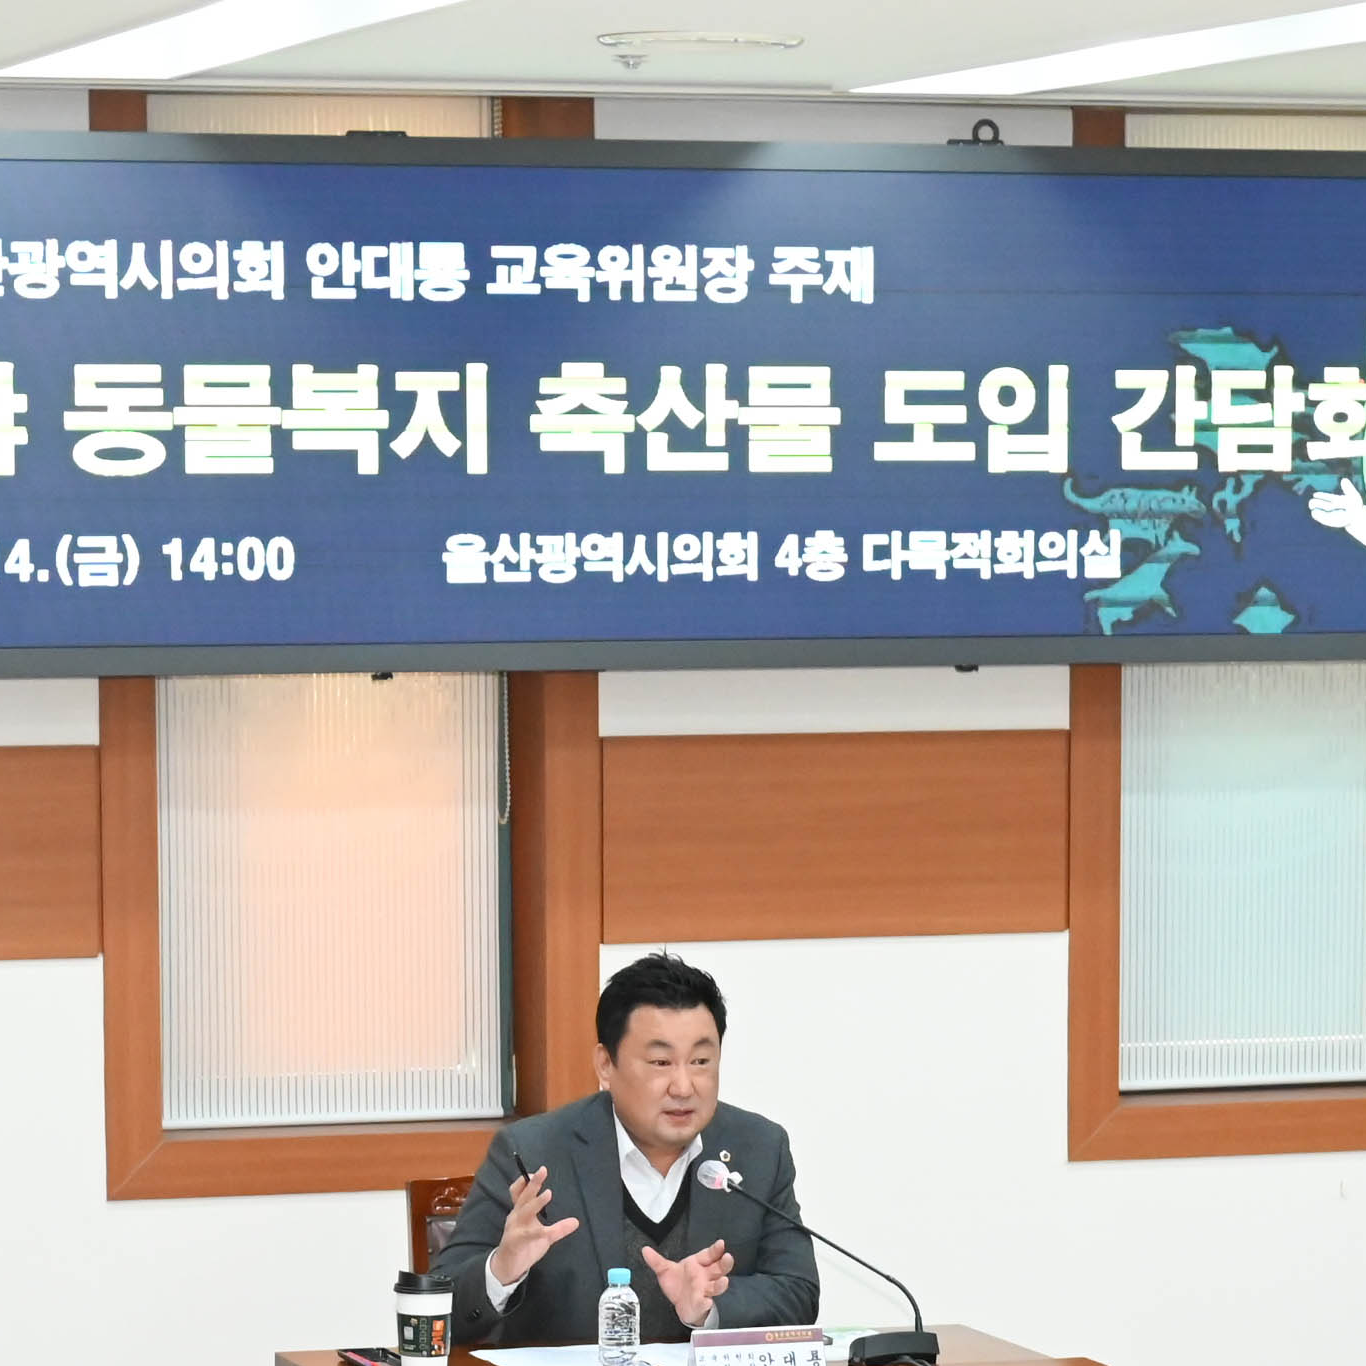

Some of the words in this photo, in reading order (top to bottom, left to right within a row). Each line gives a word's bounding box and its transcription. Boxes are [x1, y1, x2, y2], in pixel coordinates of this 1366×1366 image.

[486, 243, 755, 303] 교육위원장
[769, 246, 874, 304] 주재
[63, 363, 488, 477] 동물복지
[530, 362, 841, 474] 축산물
[874, 364, 1069, 473] 도입
[162, 536, 295, 581] 14:00
[441, 531, 758, 583] 울산광역시의회
[775, 530, 848, 581] 4층
[863, 529, 1122, 580] 다목적회의실
